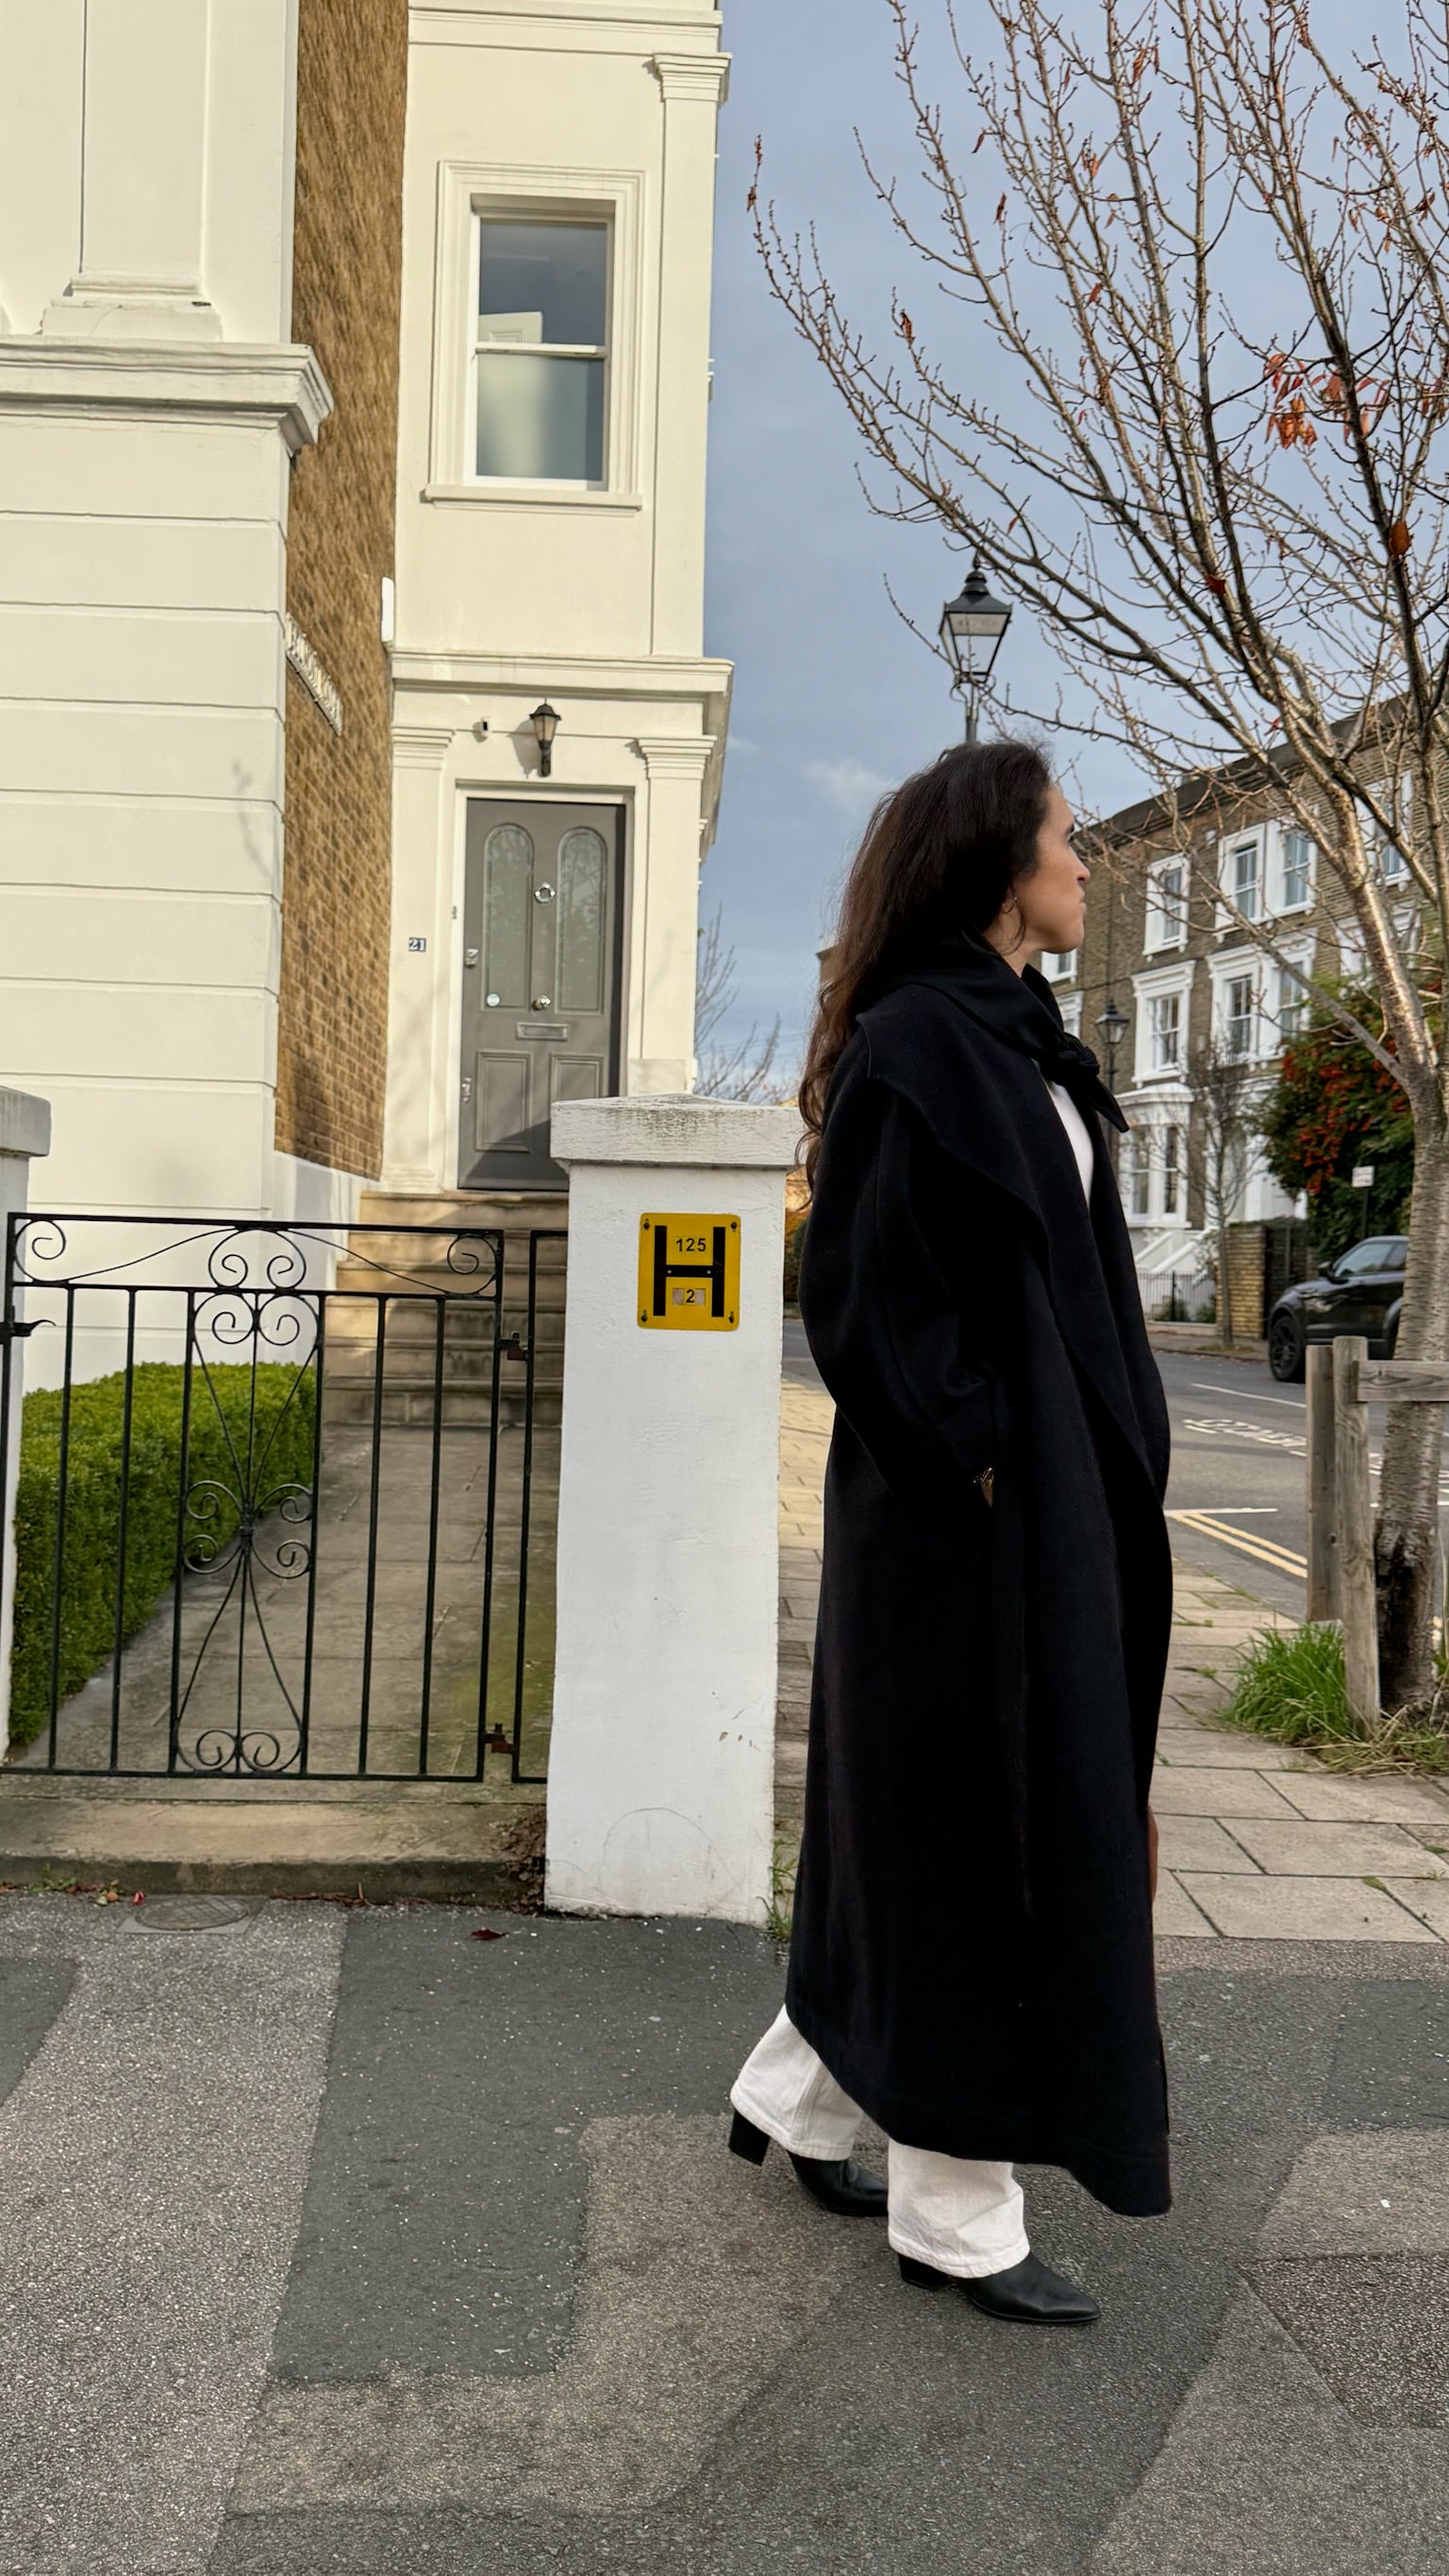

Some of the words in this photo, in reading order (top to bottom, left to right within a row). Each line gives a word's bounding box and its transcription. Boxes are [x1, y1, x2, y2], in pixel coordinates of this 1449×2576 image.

[408, 939, 425, 951] 21
[675, 1238, 707, 1252] 125
[653, 1225, 725, 1317] H
[686, 1289, 695, 1303] 2
